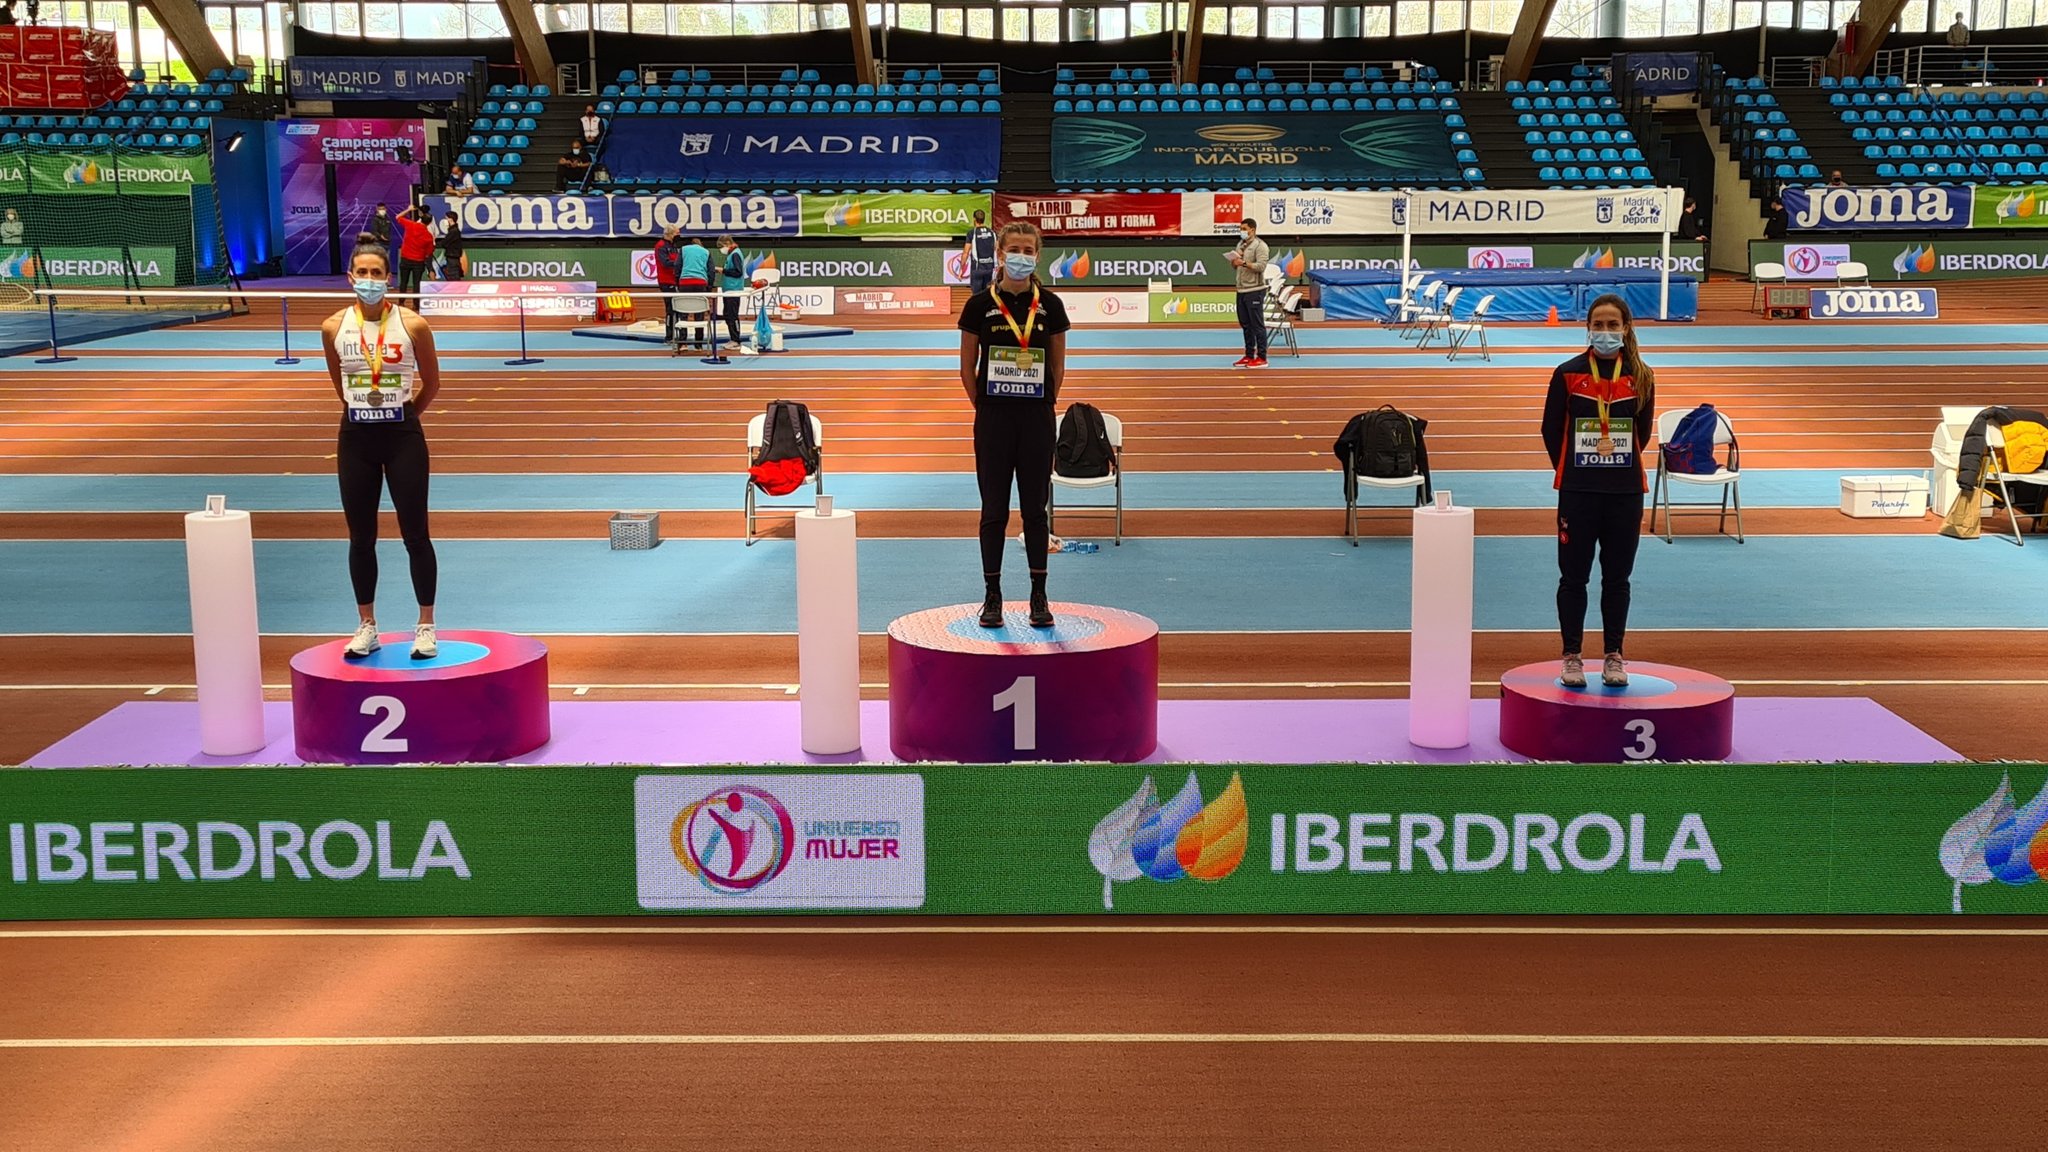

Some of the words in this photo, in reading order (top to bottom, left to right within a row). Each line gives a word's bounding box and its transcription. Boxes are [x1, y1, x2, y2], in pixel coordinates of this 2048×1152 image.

[313, 71, 381, 85] MADRID
[322, 137, 413, 149] Campeonato
[743, 135, 940, 154] MADRID
[325, 148, 384, 161] ESPAÑA
[1195, 152, 1298, 165] MADRID
[100, 168, 194, 182] IBERDROLA
[1027, 201, 1072, 216] MADRID
[1296, 197, 1327, 207] Madrid
[1623, 197, 1655, 206] Madrid
[1796, 187, 1954, 228] Joma
[629, 196, 782, 236] Joma
[865, 208, 969, 224] IBERDROLA
[1429, 200, 1545, 221] MADRID
[1041, 217, 1062, 230] UNA
[1065, 213, 1100, 229] REGIÓN
[1104, 215, 1117, 228] EN
[1121, 214, 1156, 228] FORMA
[1295, 215, 1332, 226] Deporte
[1622, 214, 1659, 225] Deporte
[472, 261, 586, 277] IBERDROLA
[780, 261, 893, 277] IBERDROLA
[1094, 260, 1208, 276] IBERDROLA
[420, 297, 515, 311] Campeonato
[1190, 303, 1237, 313] IBERDR
[1822, 290, 1925, 316] Joma
[994, 366, 1022, 376] MADRID
[1024, 368, 1039, 377] 2021
[993, 383, 1036, 394] Joma
[354, 409, 396, 420] Joma
[993, 676, 1036, 750] 1
[360, 695, 408, 752] 2
[1623, 719, 1657, 759] 3
[804, 821, 899, 836] UNIVERSO
[805, 838, 899, 859] MUJER
[1271, 812, 1722, 873] IBERDROLA
[9, 819, 472, 882] IBERDROLA
